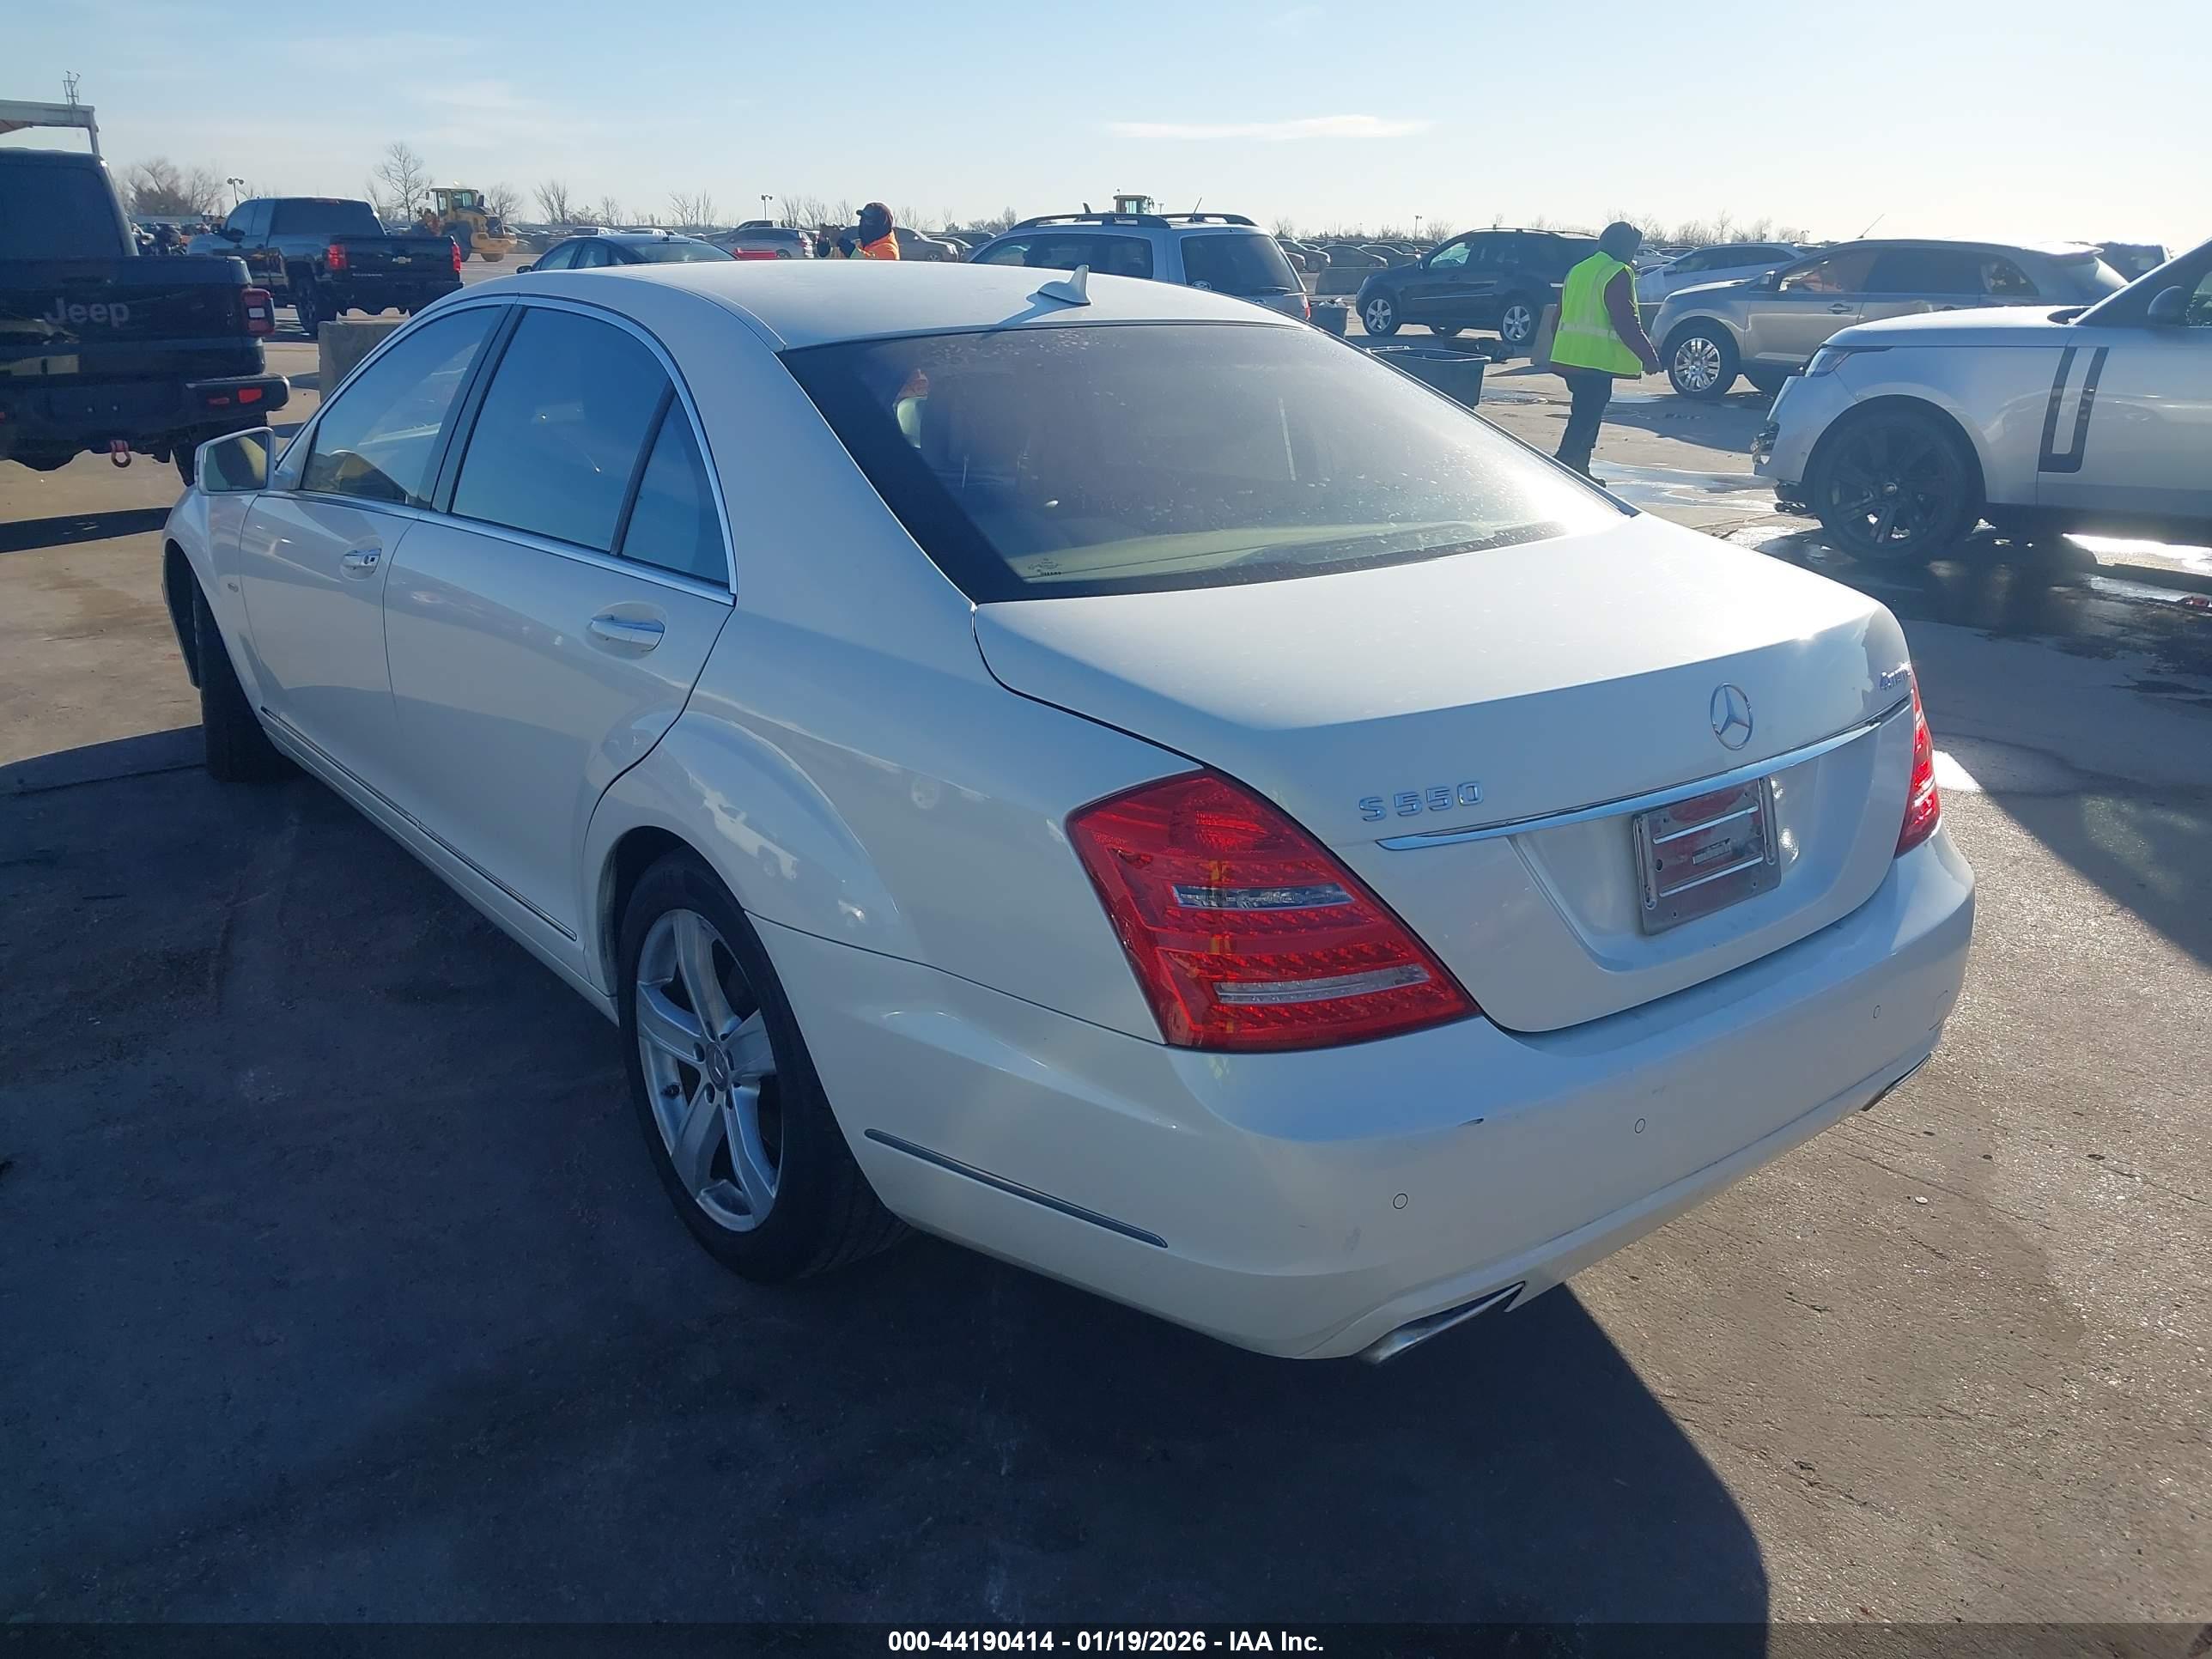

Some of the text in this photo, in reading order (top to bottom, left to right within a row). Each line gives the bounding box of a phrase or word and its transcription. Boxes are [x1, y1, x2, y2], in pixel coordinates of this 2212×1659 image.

[43, 296, 130, 328] Jeep
[1359, 781, 1484, 822] S 550
